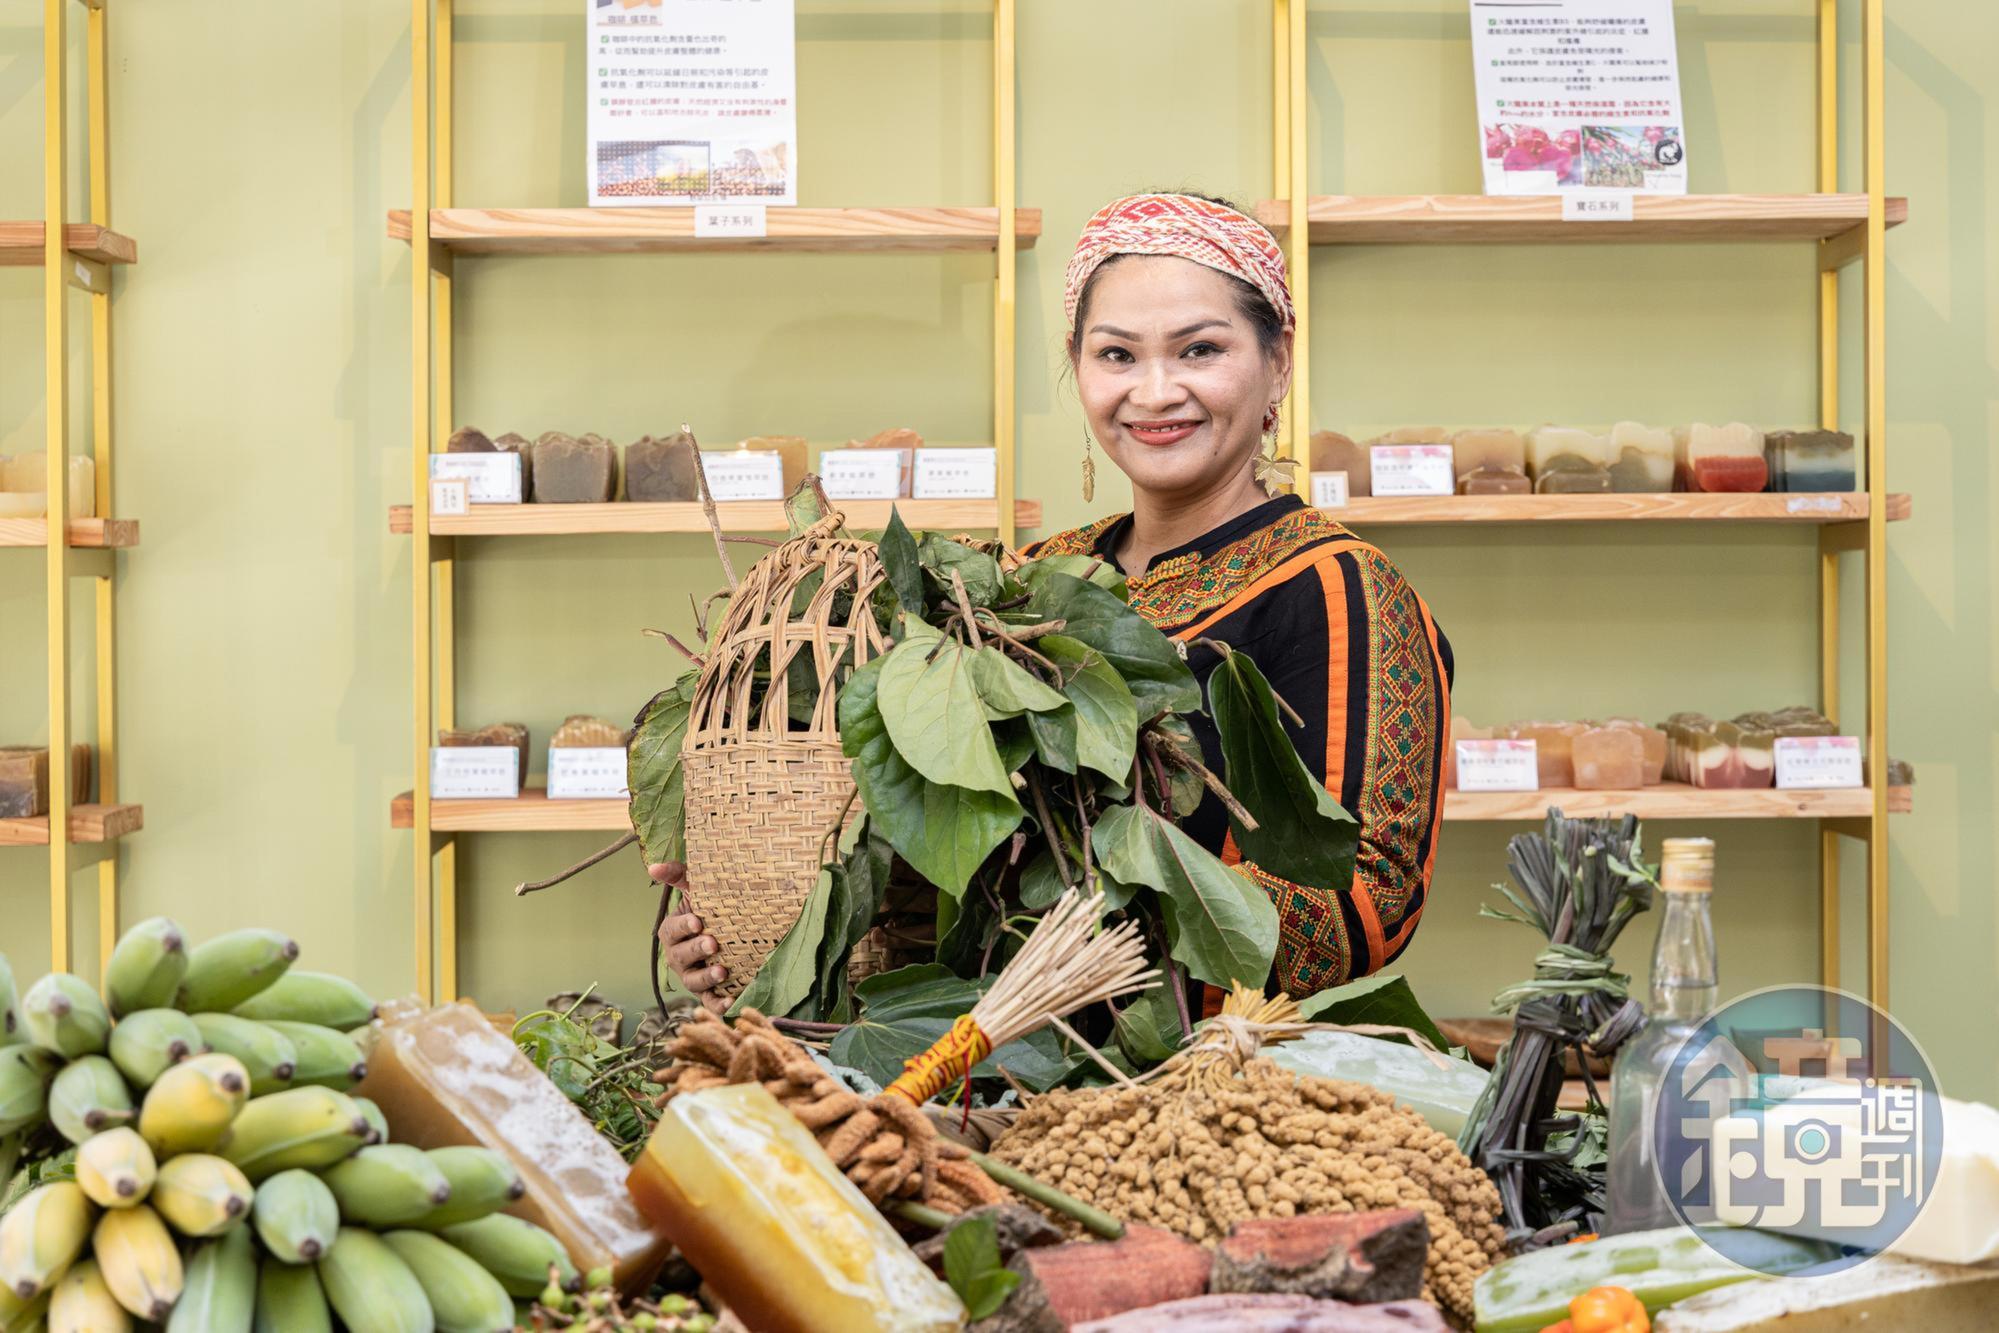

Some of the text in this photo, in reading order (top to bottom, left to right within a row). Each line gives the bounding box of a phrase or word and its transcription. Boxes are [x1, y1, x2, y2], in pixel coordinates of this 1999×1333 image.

[1575, 200, 1619, 212] 寶石系列
[708, 215, 753, 227] 葉子系列
